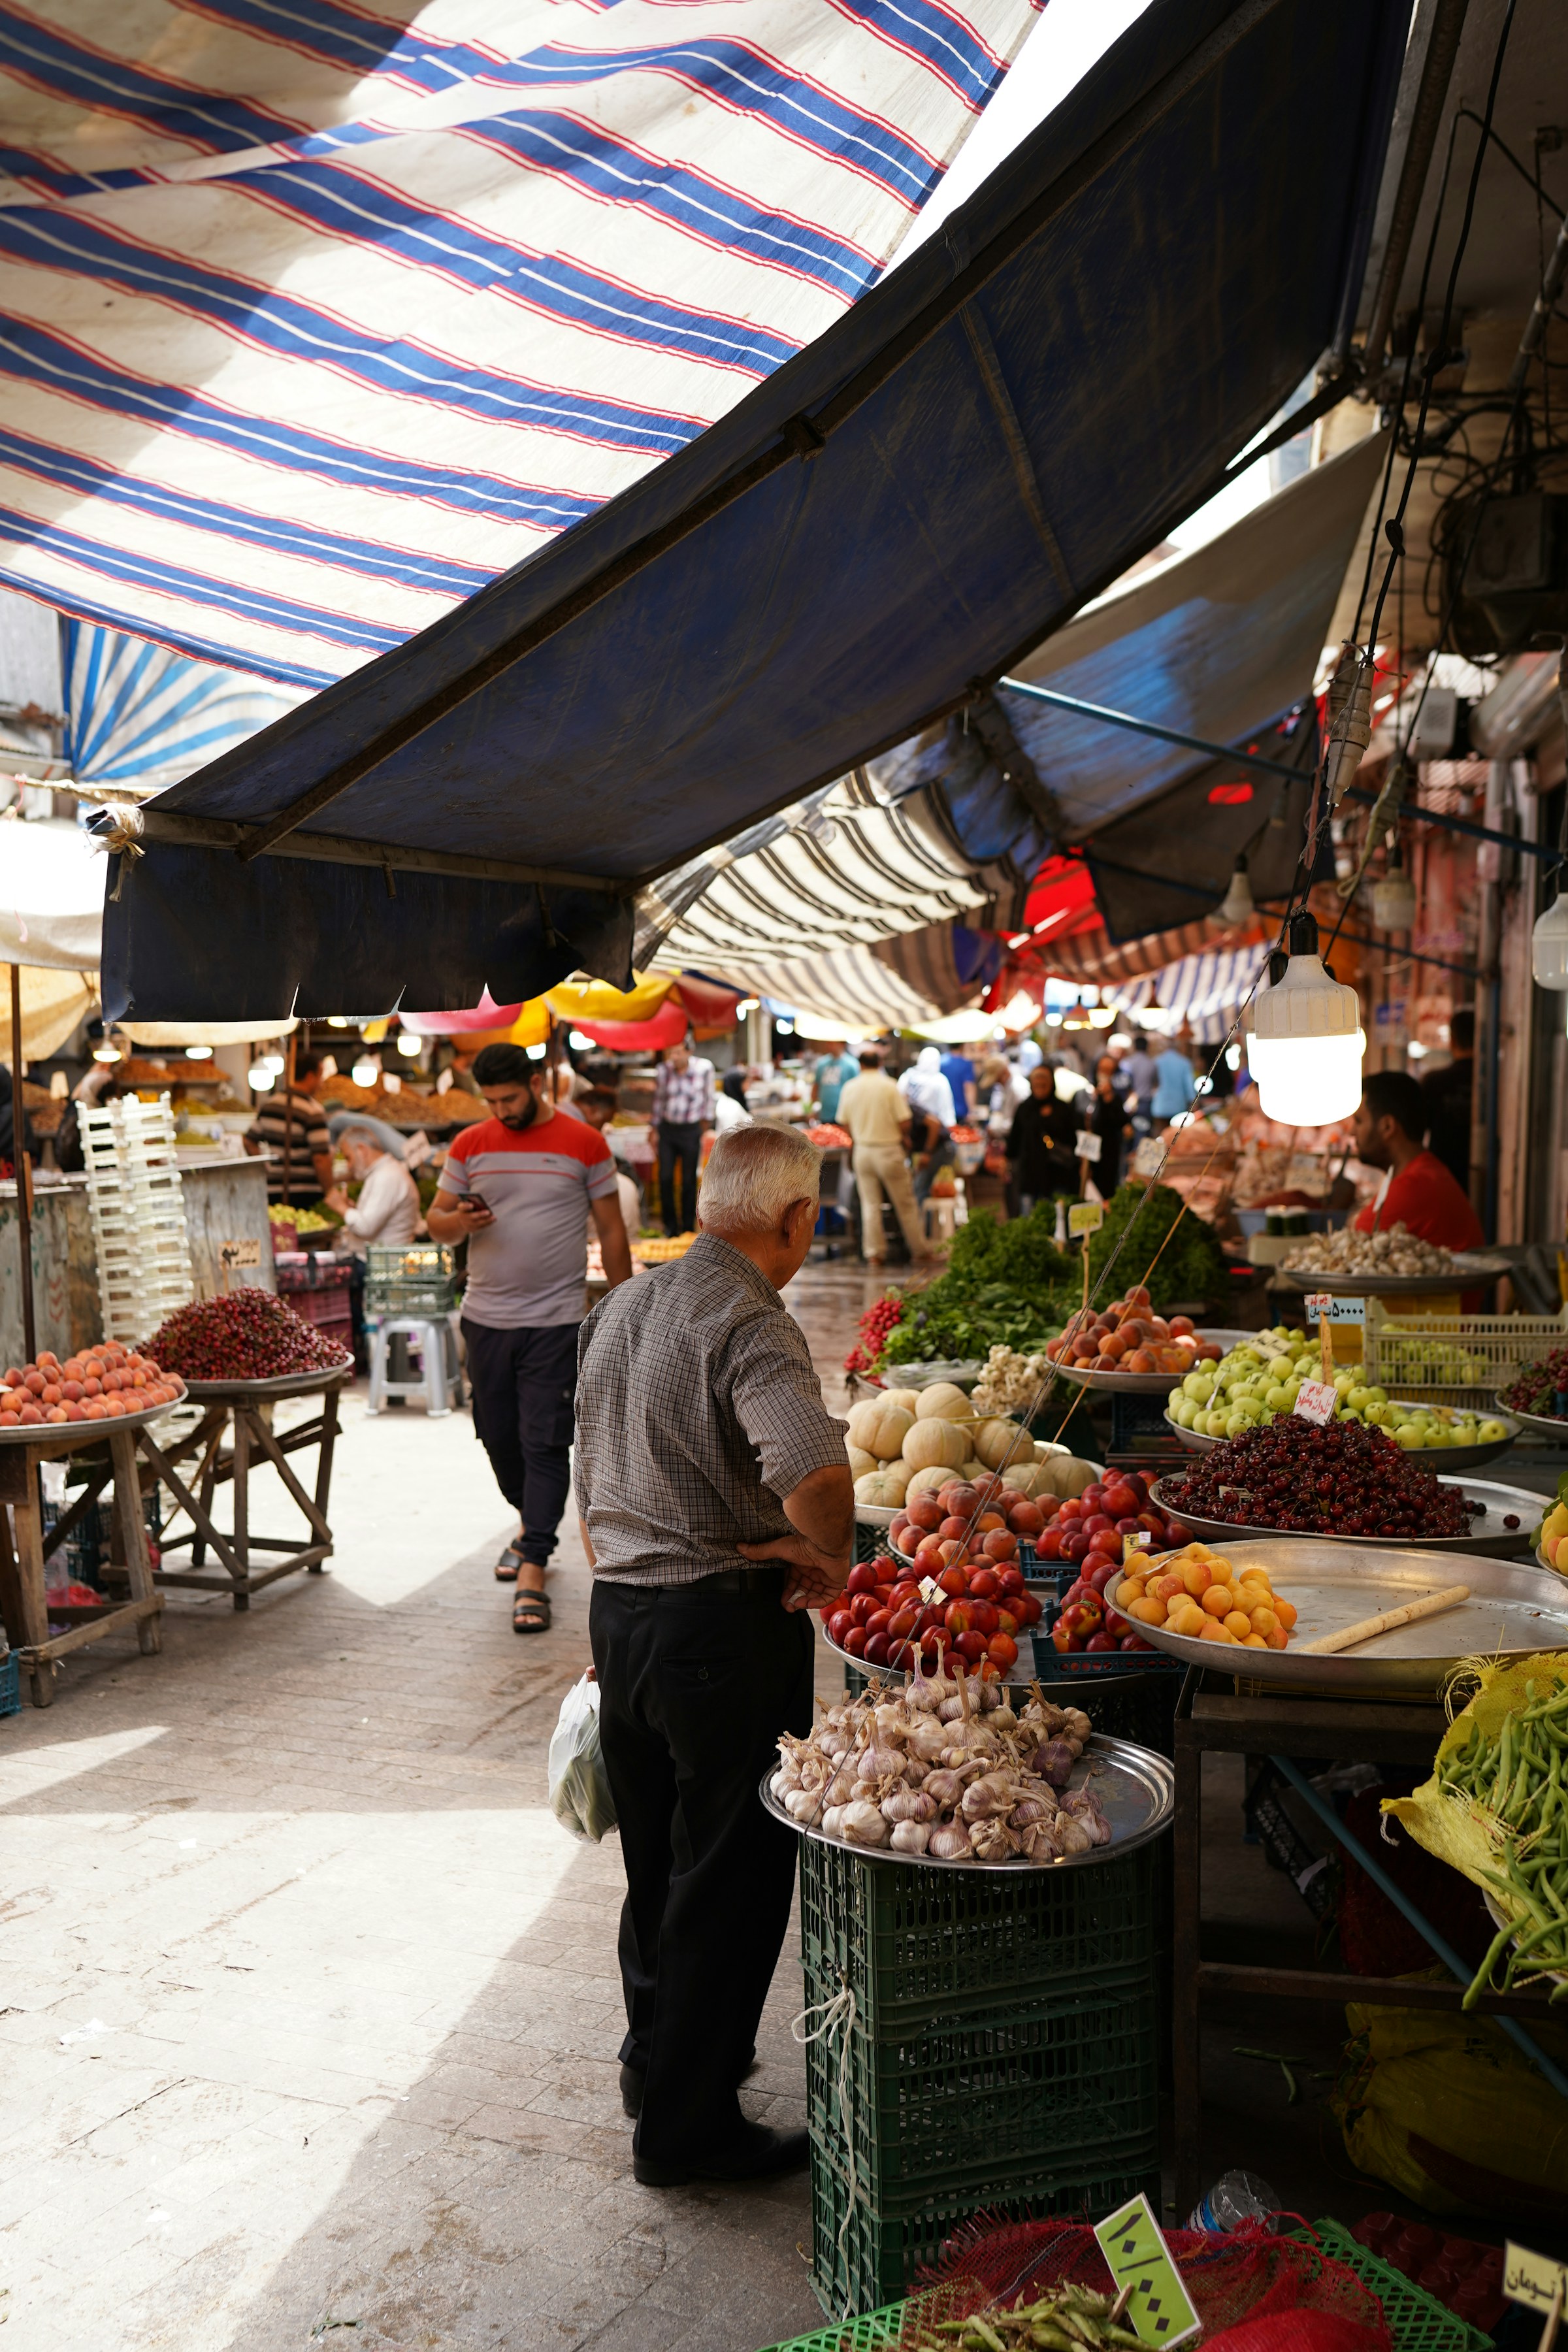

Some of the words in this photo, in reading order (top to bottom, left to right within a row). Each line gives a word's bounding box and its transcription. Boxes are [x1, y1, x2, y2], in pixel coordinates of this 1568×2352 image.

[1332, 1302, 1364, 1317] ۵۰۰۰۰
[1107, 2212, 1169, 2332] ۱۰/۰۰۰
[1507, 2267, 1557, 2300] تومان
